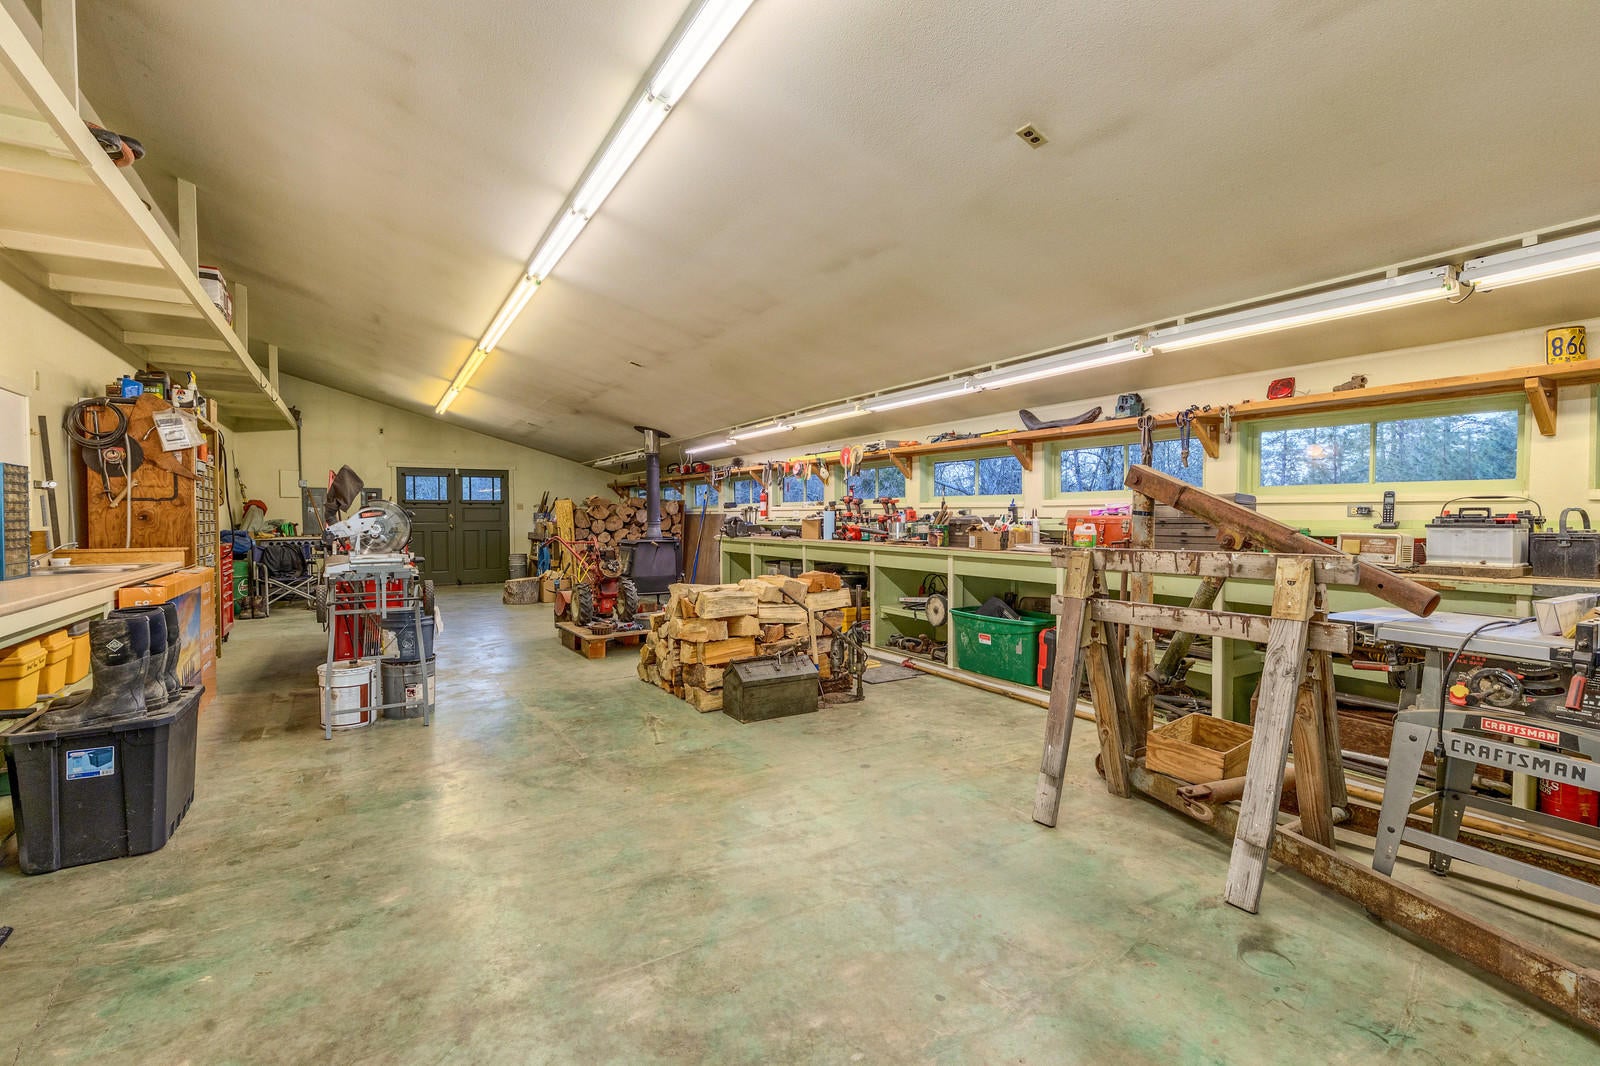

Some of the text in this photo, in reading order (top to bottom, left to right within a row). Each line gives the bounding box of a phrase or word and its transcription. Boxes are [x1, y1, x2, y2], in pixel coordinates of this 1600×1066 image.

[1551, 335, 1586, 357] 866
[1485, 720, 1556, 741] CRAFTSMAN
[1451, 739, 1587, 781] CRAFTSMAN
